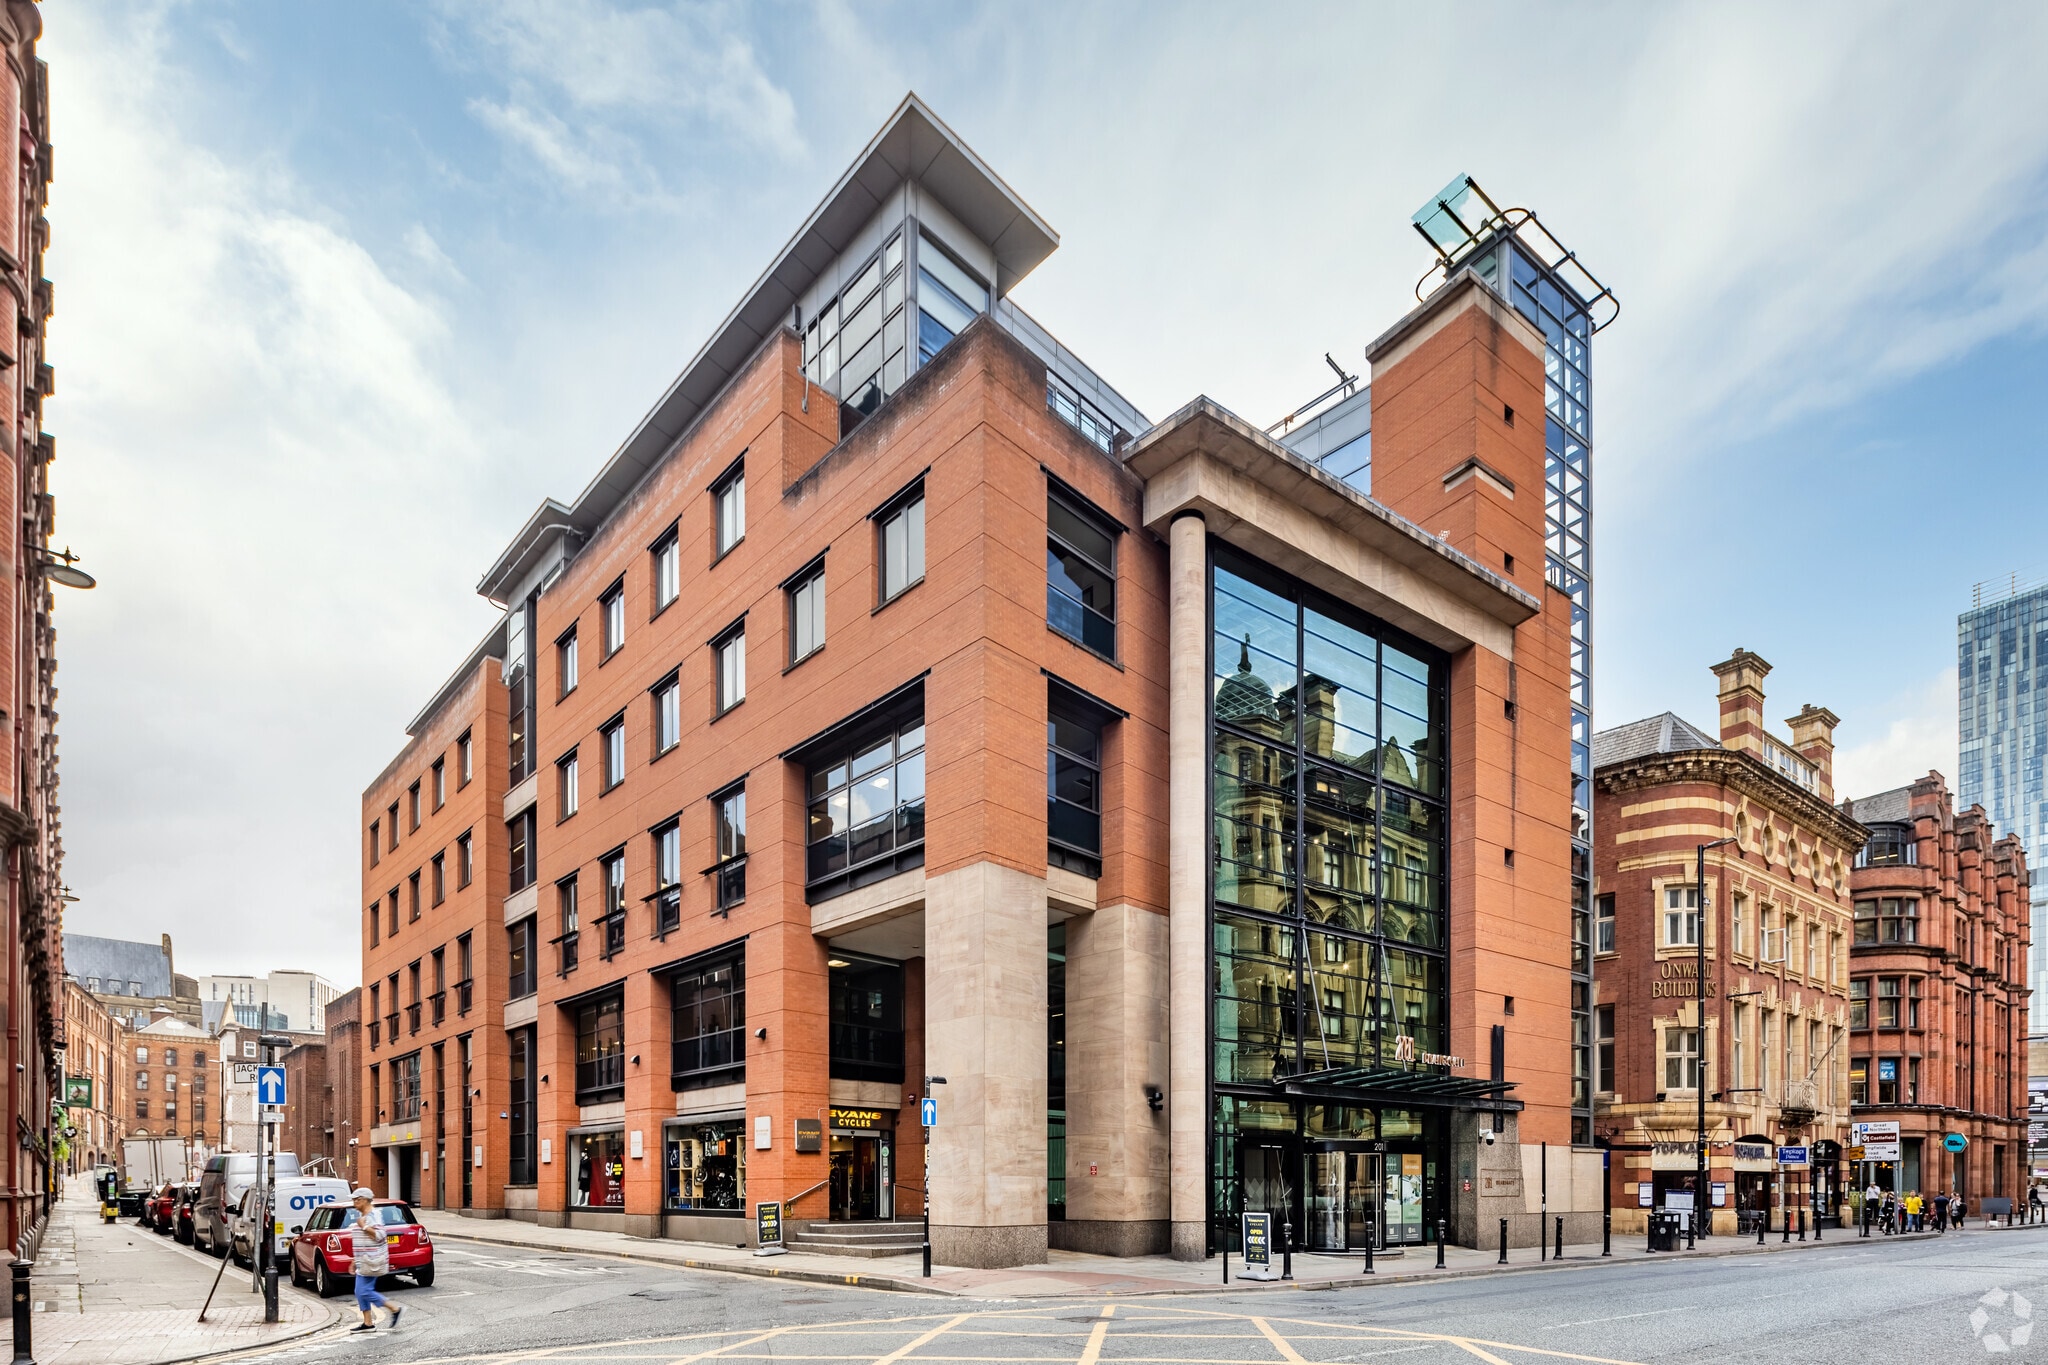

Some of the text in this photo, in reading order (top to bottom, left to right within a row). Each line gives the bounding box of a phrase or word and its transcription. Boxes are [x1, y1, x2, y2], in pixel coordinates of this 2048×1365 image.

[1661, 962, 1713, 979] ONWAD
[1652, 981, 1717, 998] BUILDIGS
[829, 1109, 881, 1120] EVANS
[838, 1120, 871, 1128] CYCLES
[1374, 1142, 1384, 1151] 201
[290, 1195, 336, 1210] OTIS
